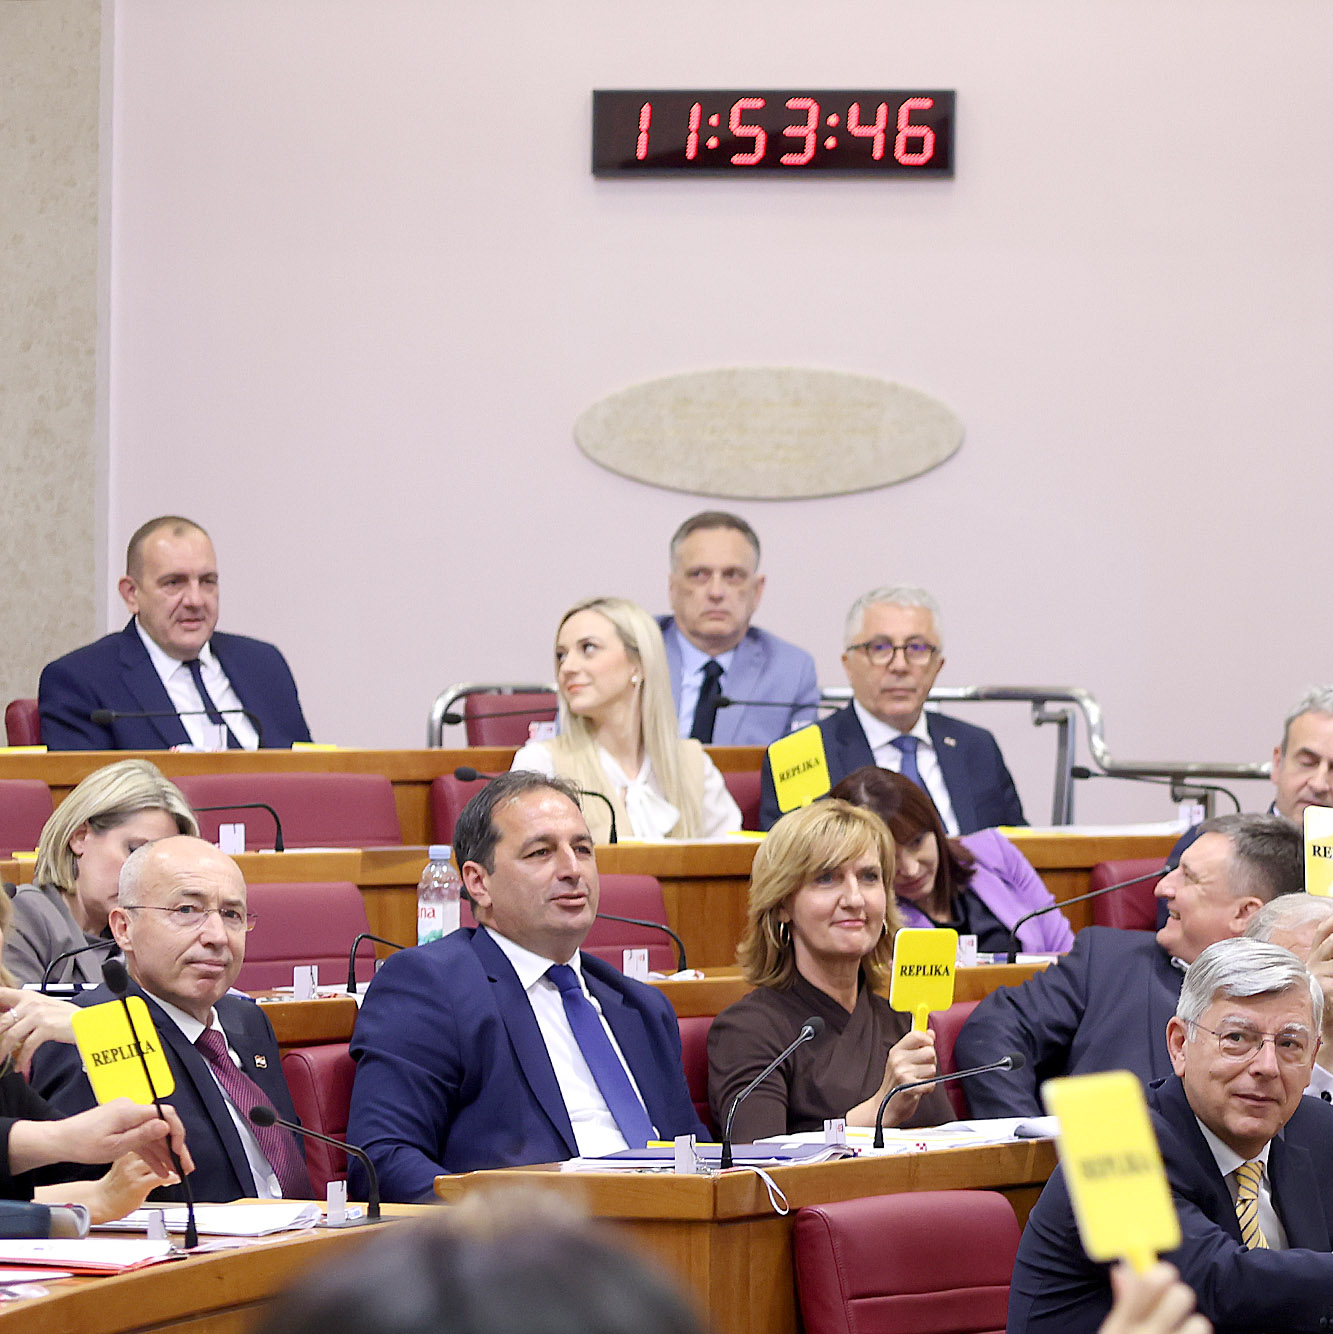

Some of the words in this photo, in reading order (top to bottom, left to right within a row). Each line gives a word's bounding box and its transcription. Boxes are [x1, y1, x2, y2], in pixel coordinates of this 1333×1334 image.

[635, 97, 935, 166] 11:53:46
[779, 757, 820, 783] REPLIKA
[418, 907, 436, 919] na
[900, 964, 950, 977] REPLIKA
